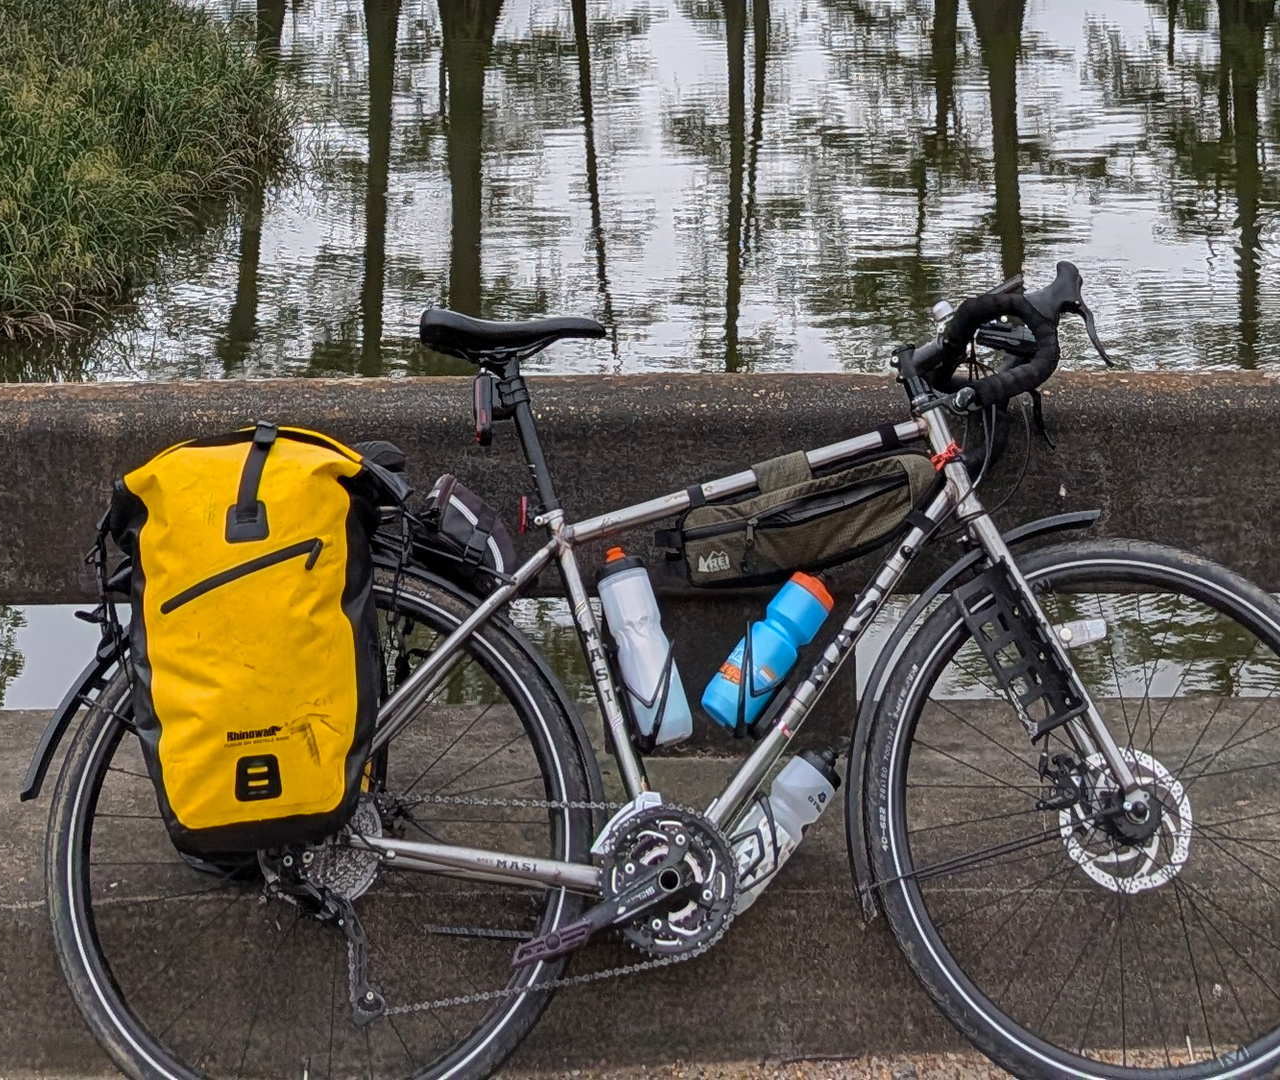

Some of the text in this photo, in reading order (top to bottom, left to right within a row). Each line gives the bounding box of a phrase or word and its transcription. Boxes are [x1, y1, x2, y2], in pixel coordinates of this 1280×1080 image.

[582, 627, 613, 703] MASI
[809, 583, 884, 690] MASI
[496, 859, 538, 872] MASI
